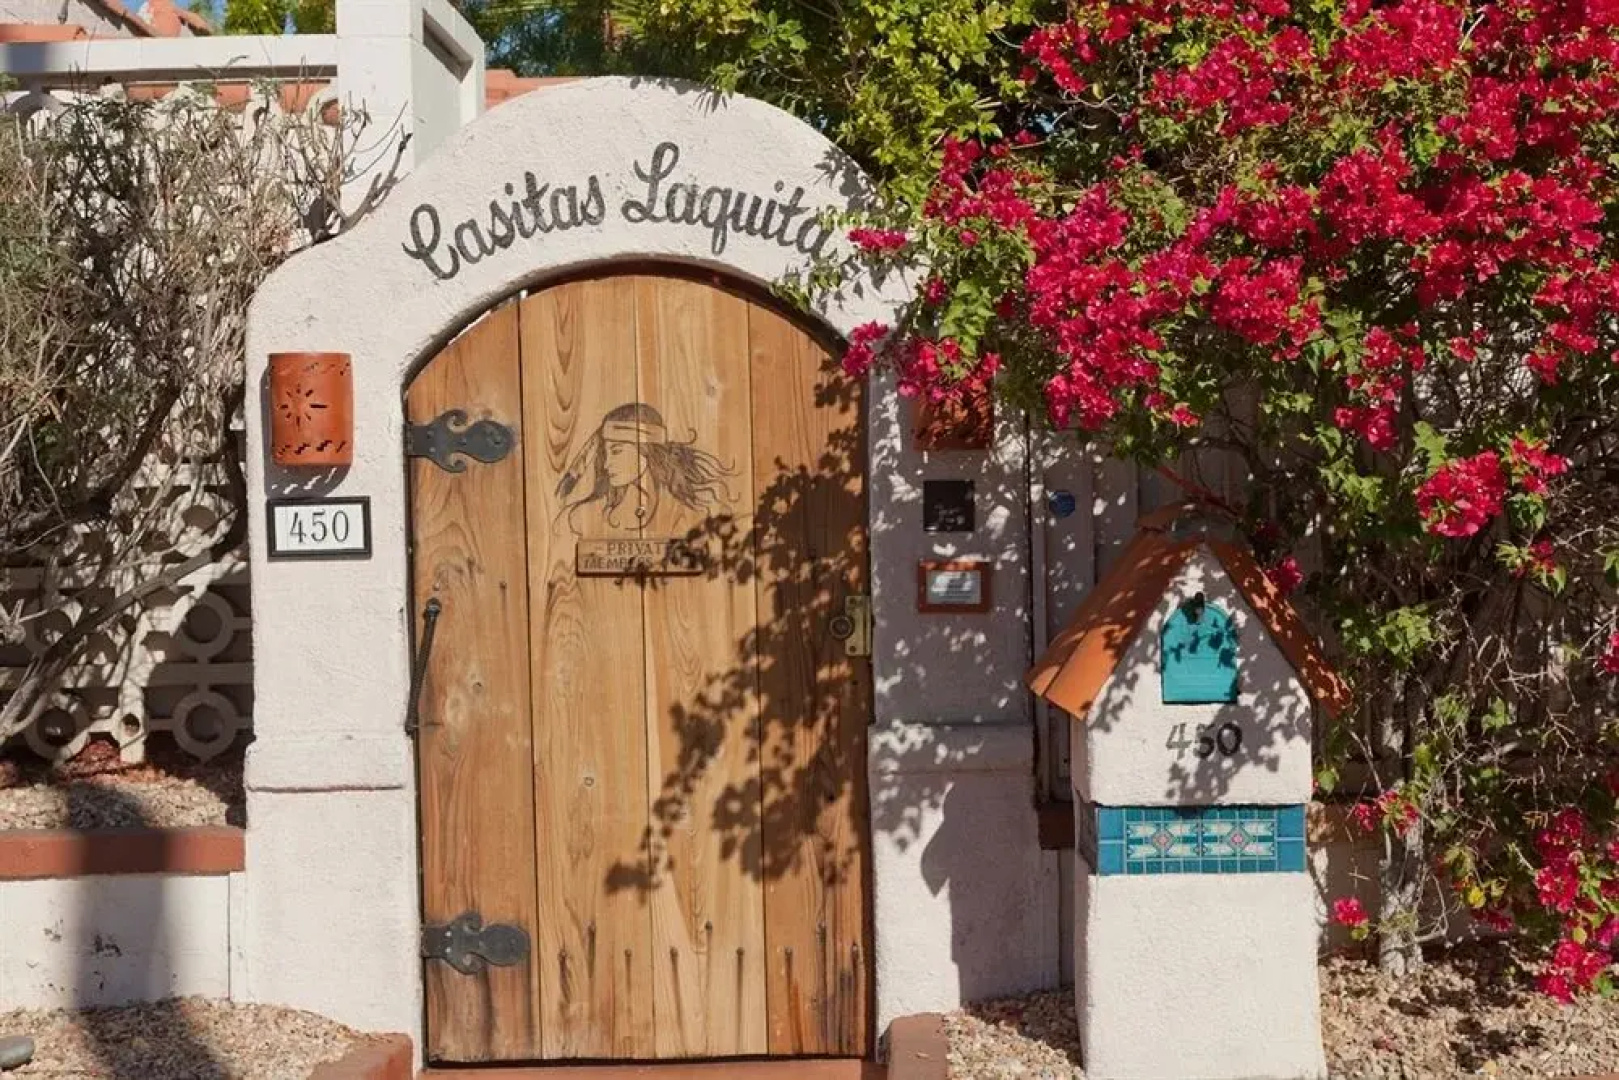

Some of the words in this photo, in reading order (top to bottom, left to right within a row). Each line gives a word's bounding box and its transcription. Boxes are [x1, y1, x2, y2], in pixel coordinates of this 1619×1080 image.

[402, 171, 606, 280] Casitas
[621, 141, 835, 262] Laquita
[289, 508, 350, 543] 450
[606, 541, 673, 556] PRIVAT
[1166, 721, 1243, 760] 450
